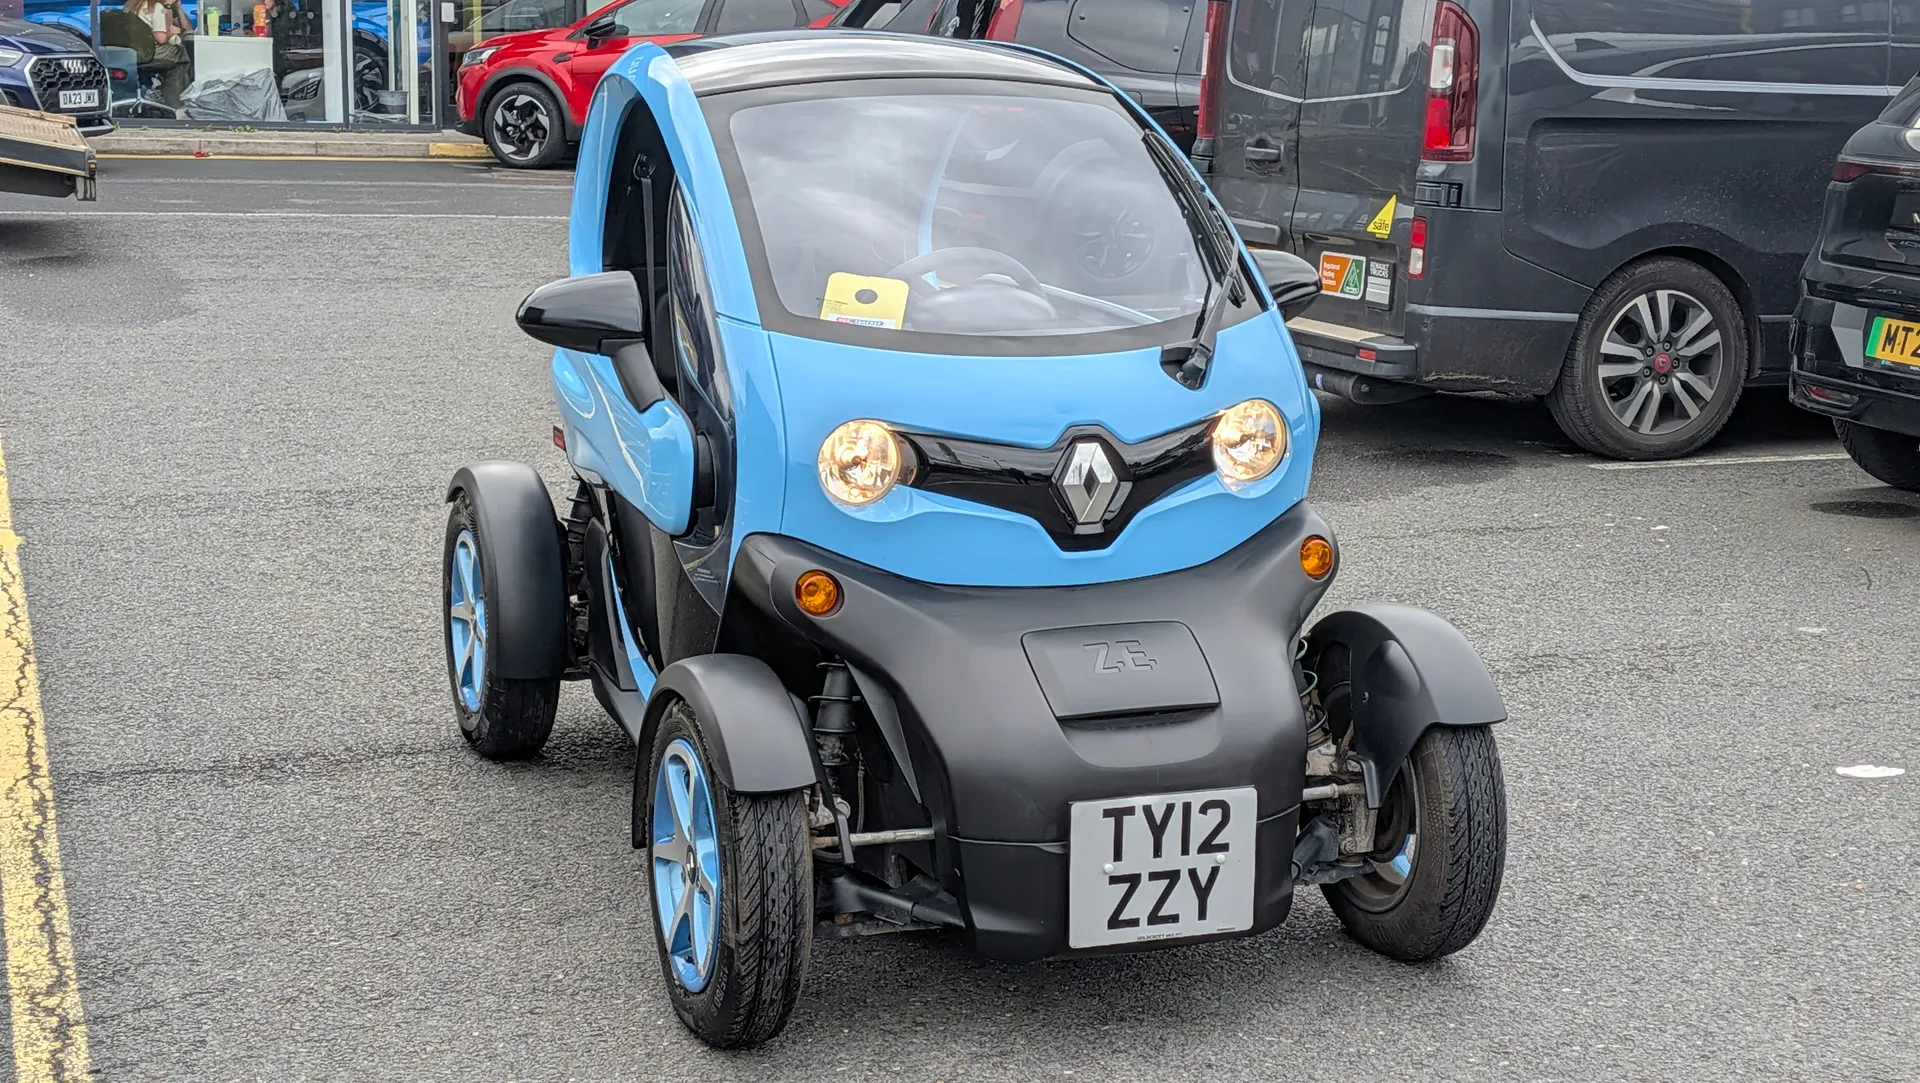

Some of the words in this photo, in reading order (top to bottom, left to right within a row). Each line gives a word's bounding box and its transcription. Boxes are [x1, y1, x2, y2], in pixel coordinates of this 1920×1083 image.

[63, 92, 82, 105] DA23
[1102, 799, 1231, 862] TY12
[1107, 866, 1221, 931] ZZY
